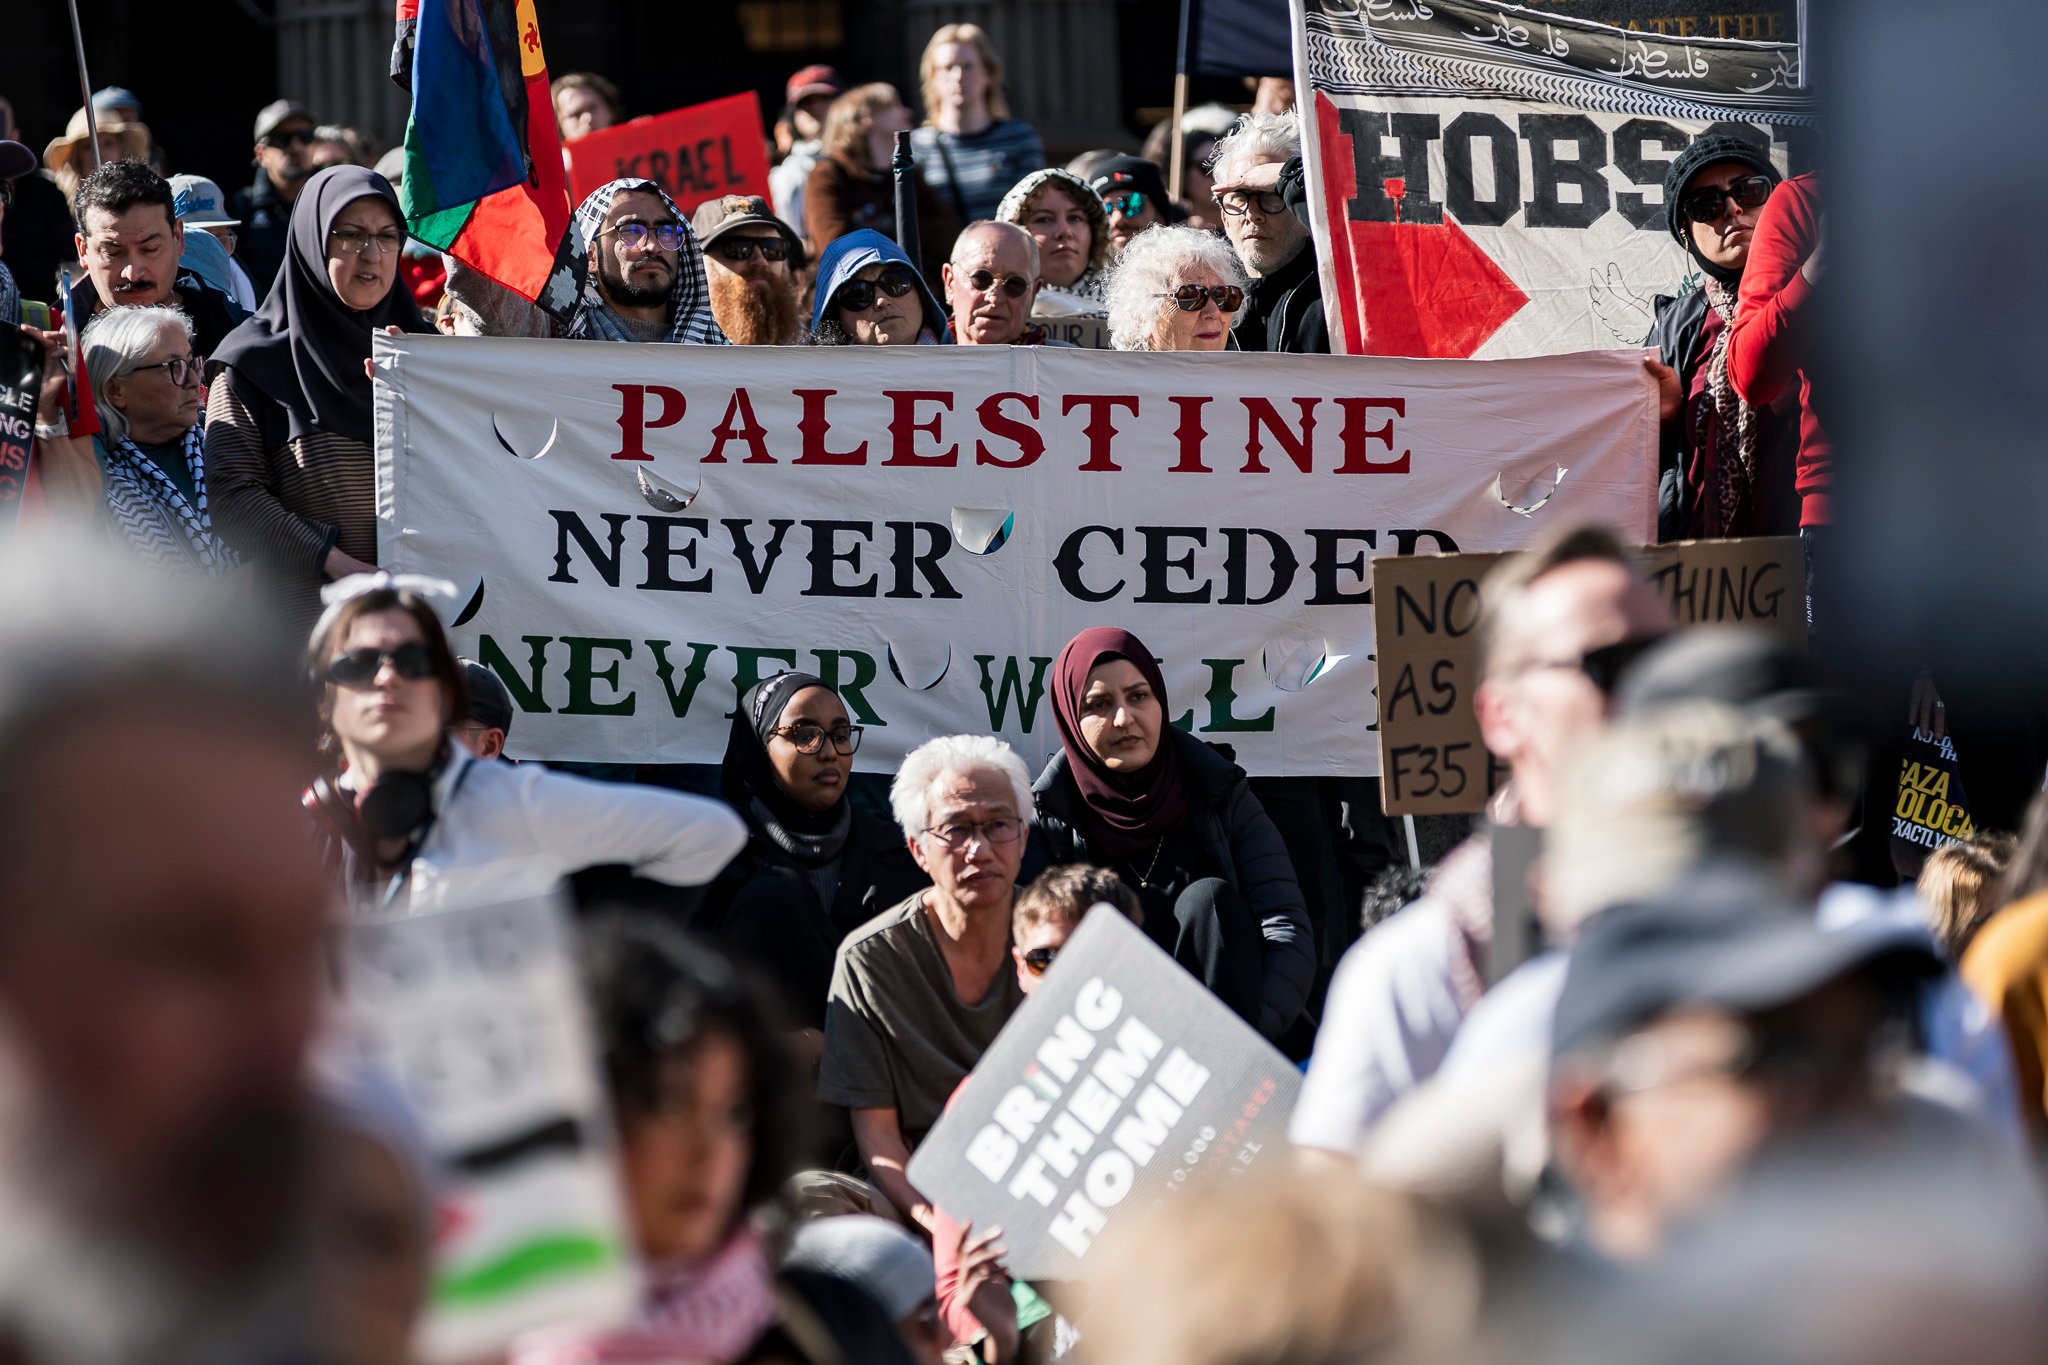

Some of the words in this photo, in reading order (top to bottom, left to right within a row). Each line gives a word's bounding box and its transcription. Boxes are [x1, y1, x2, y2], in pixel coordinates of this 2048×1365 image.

[1596, 40, 1709, 80] فلسطين
[1601, 15, 1698, 37] ATE
[1339, 107, 1822, 232] HOBS
[611, 382, 1412, 475] PALESTINE
[547, 509, 964, 599] NEVER
[1394, 578, 1483, 638] NO
[973, 654, 1276, 733] WL
[1387, 658, 1457, 723] AS
[1390, 741, 1472, 801] F35
[1896, 785, 1975, 842] OLOCA
[965, 975, 1124, 1184] BRING
[1008, 1014, 1164, 1208] THEM
[1048, 1044, 1212, 1259] HOME
